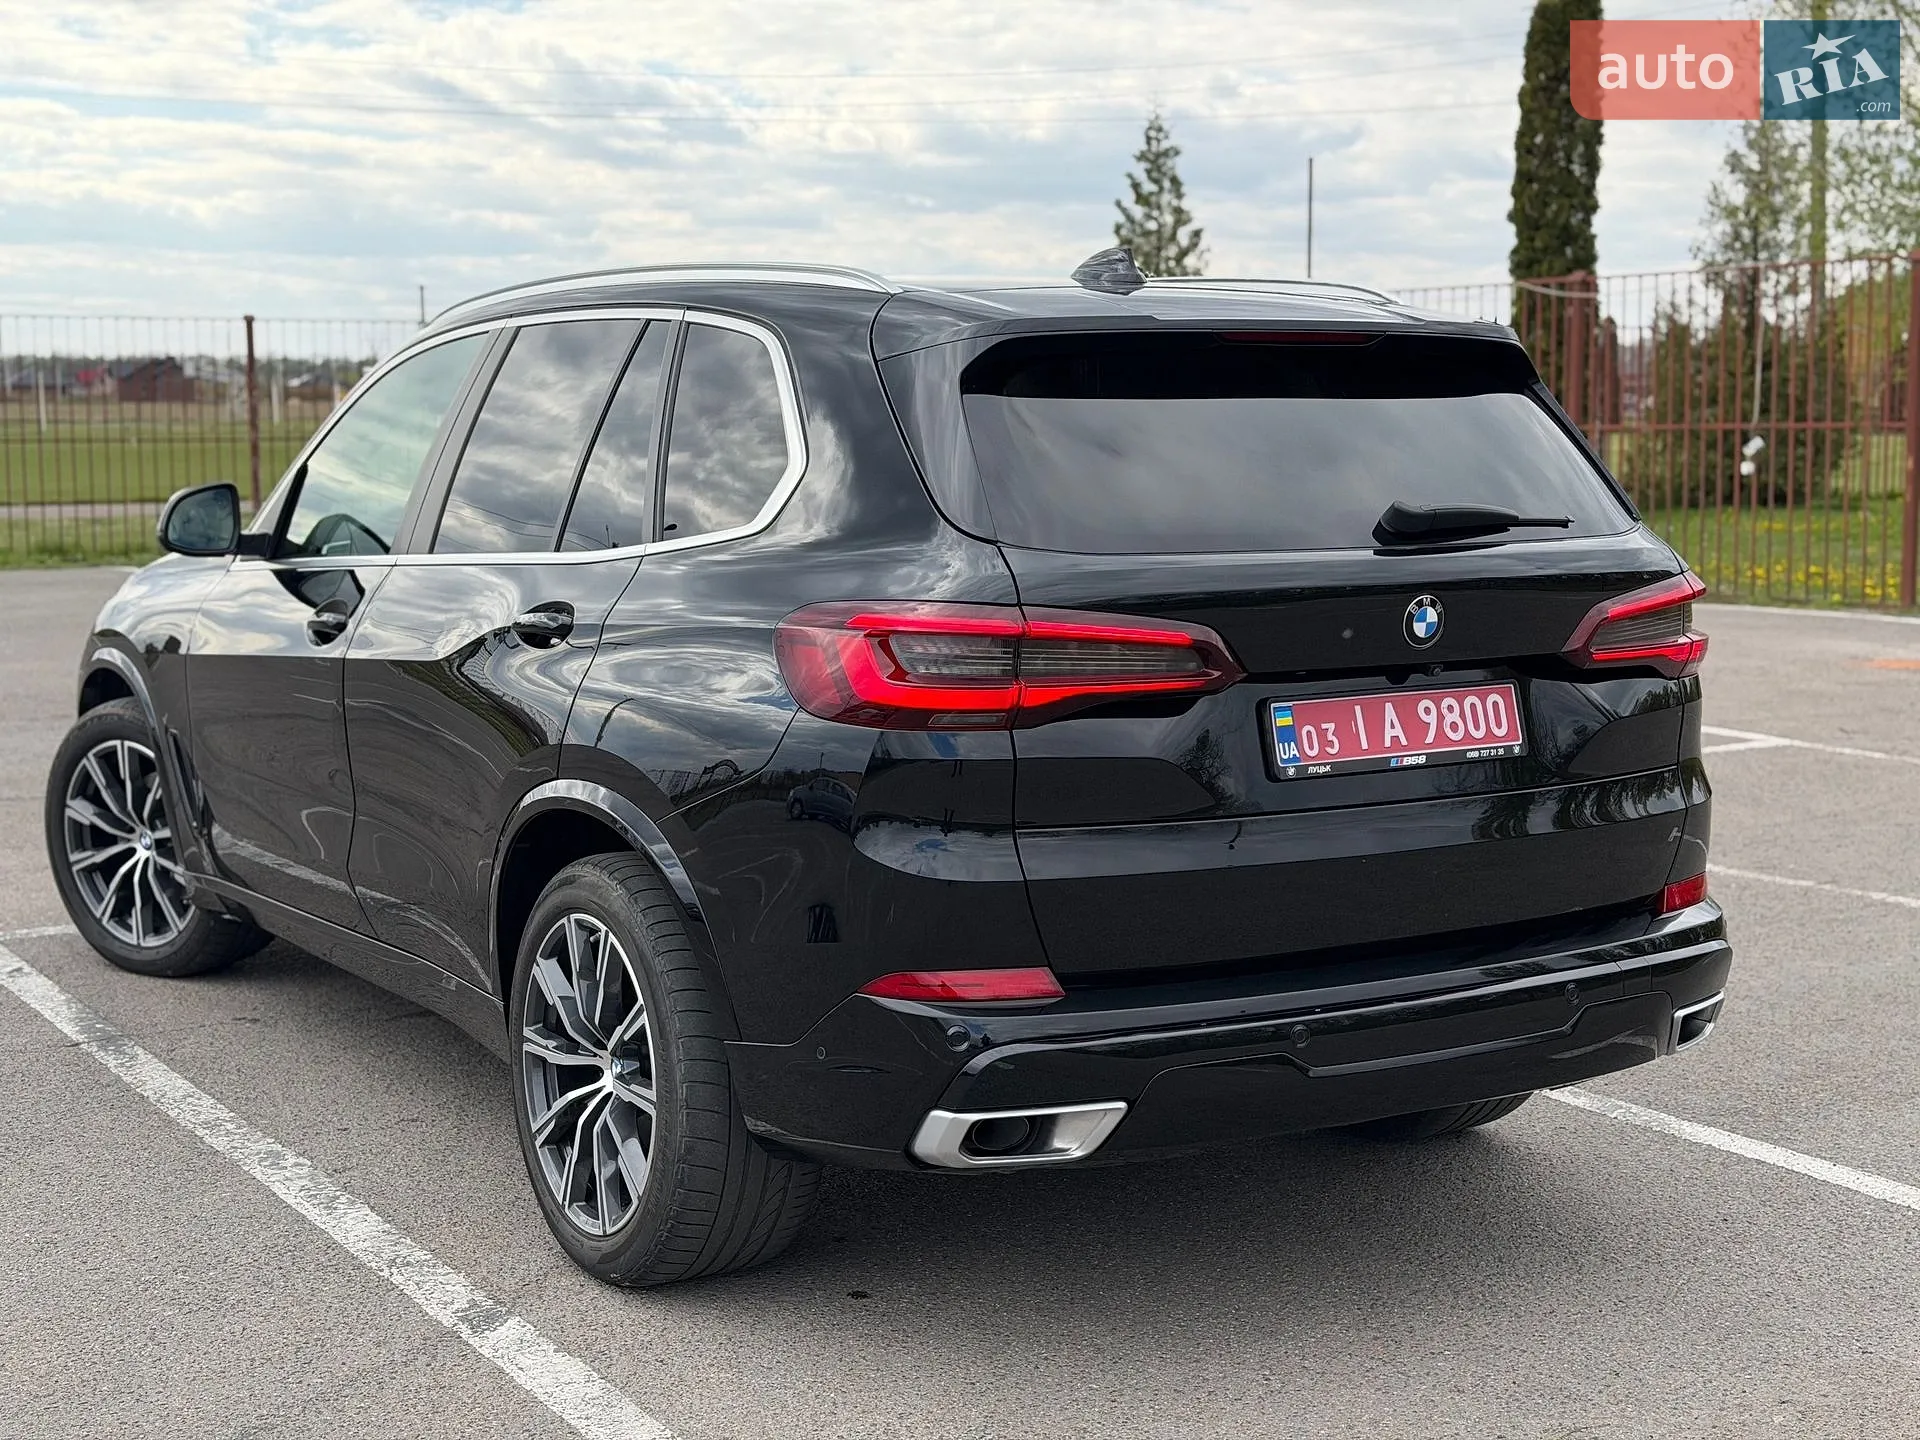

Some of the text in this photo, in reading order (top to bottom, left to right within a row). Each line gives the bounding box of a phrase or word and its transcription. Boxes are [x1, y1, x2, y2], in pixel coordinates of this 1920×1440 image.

[1410, 597, 1443, 615] BMW
[1301, 722, 1340, 757] 03
[1416, 693, 1509, 744] 9800
[1279, 741, 1300, 759] UA
[1307, 764, 1332, 774] ЛУЦЬК
[1402, 755, 1427, 765] B58
